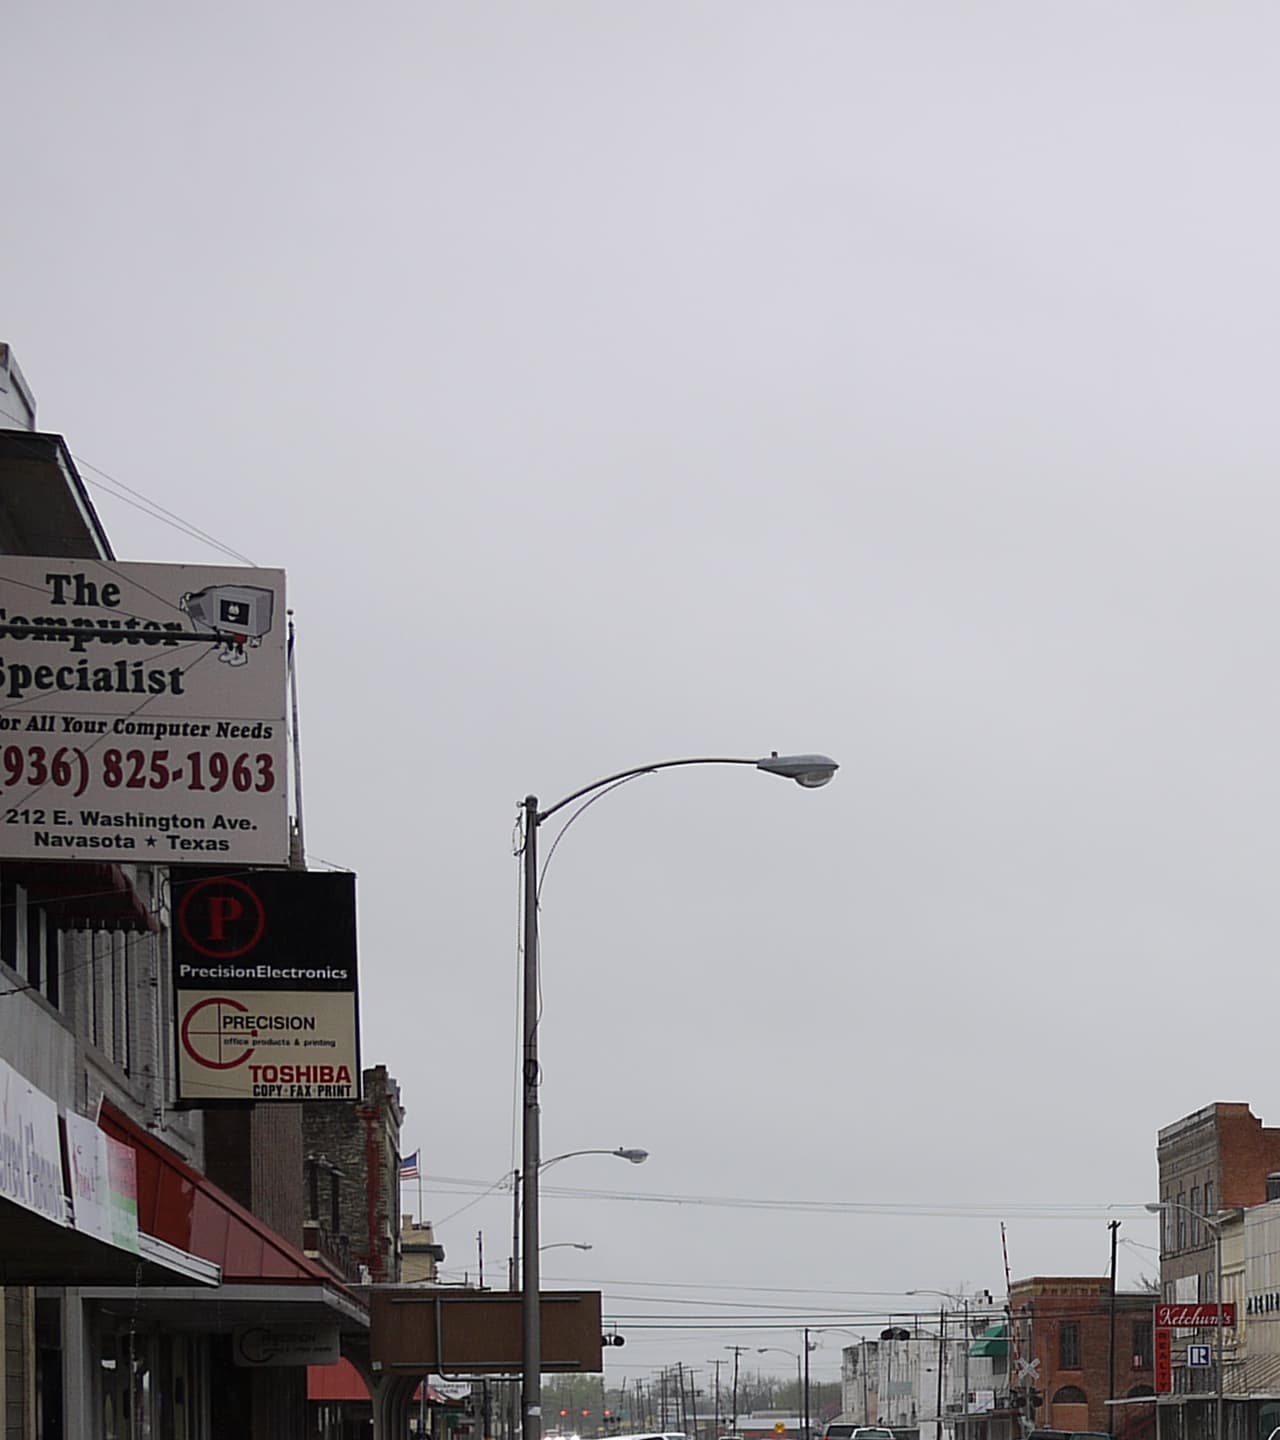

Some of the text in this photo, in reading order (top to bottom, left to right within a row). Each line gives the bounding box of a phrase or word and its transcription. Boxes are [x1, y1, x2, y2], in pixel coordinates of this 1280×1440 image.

[45, 573, 121, 606] The
[0, 715, 273, 740] or All Your Computer Needs
[0, 744, 275, 798] 936) 825-1963
[6, 809, 258, 831] 212 E. Washington Ave.
[34, 831, 230, 852] Navasota Texas
[222, 1015, 316, 1031] PRECISION
[223, 1037, 249, 1046] office
[252, 1037, 291, 1048] products
[303, 1038, 336, 1048] printing
[248, 1064, 352, 1084] TOSHIBA
[252, 1084, 352, 1098] COPY FAX PRINT
